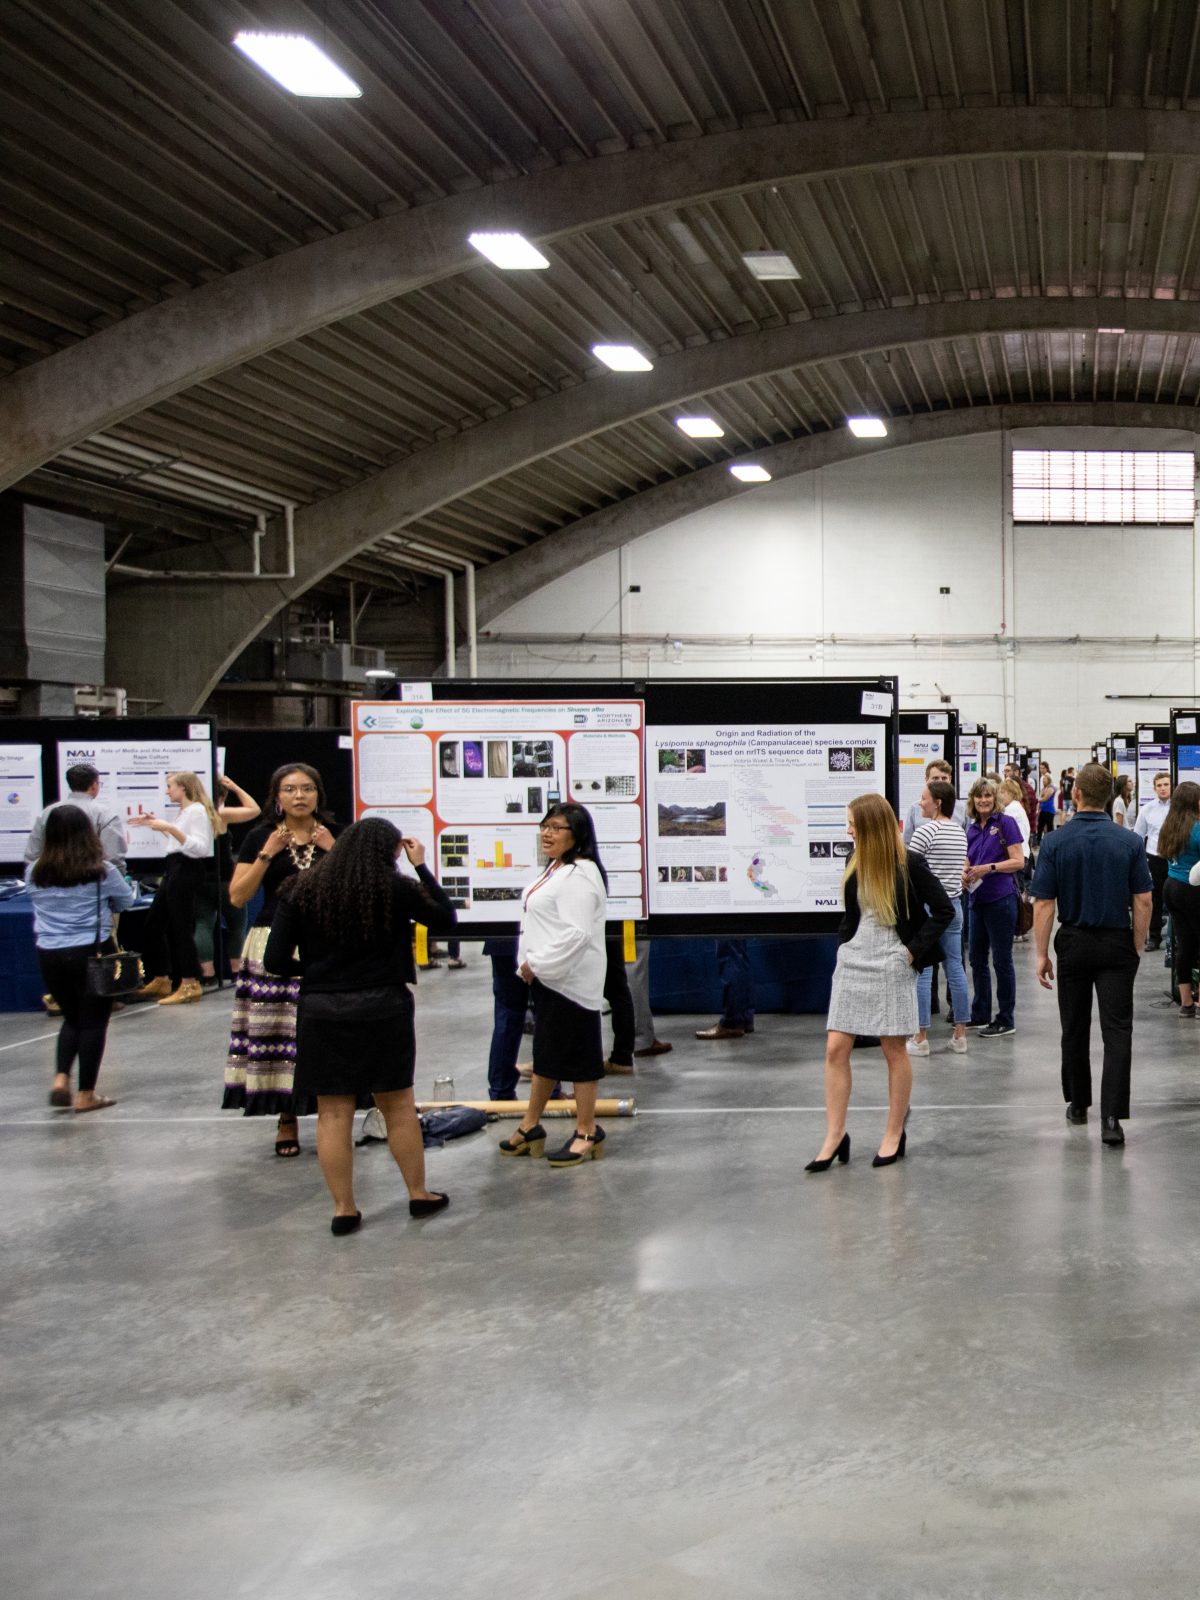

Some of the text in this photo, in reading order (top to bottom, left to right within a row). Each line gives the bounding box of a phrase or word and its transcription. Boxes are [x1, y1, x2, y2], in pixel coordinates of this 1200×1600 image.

[716, 730, 738, 738] Origin
[655, 740, 694, 748] Lysipomia
[696, 740, 746, 748] sphagnophila
[748, 739, 813, 747] (Campanulaceae)
[768, 749, 804, 757] sequence
